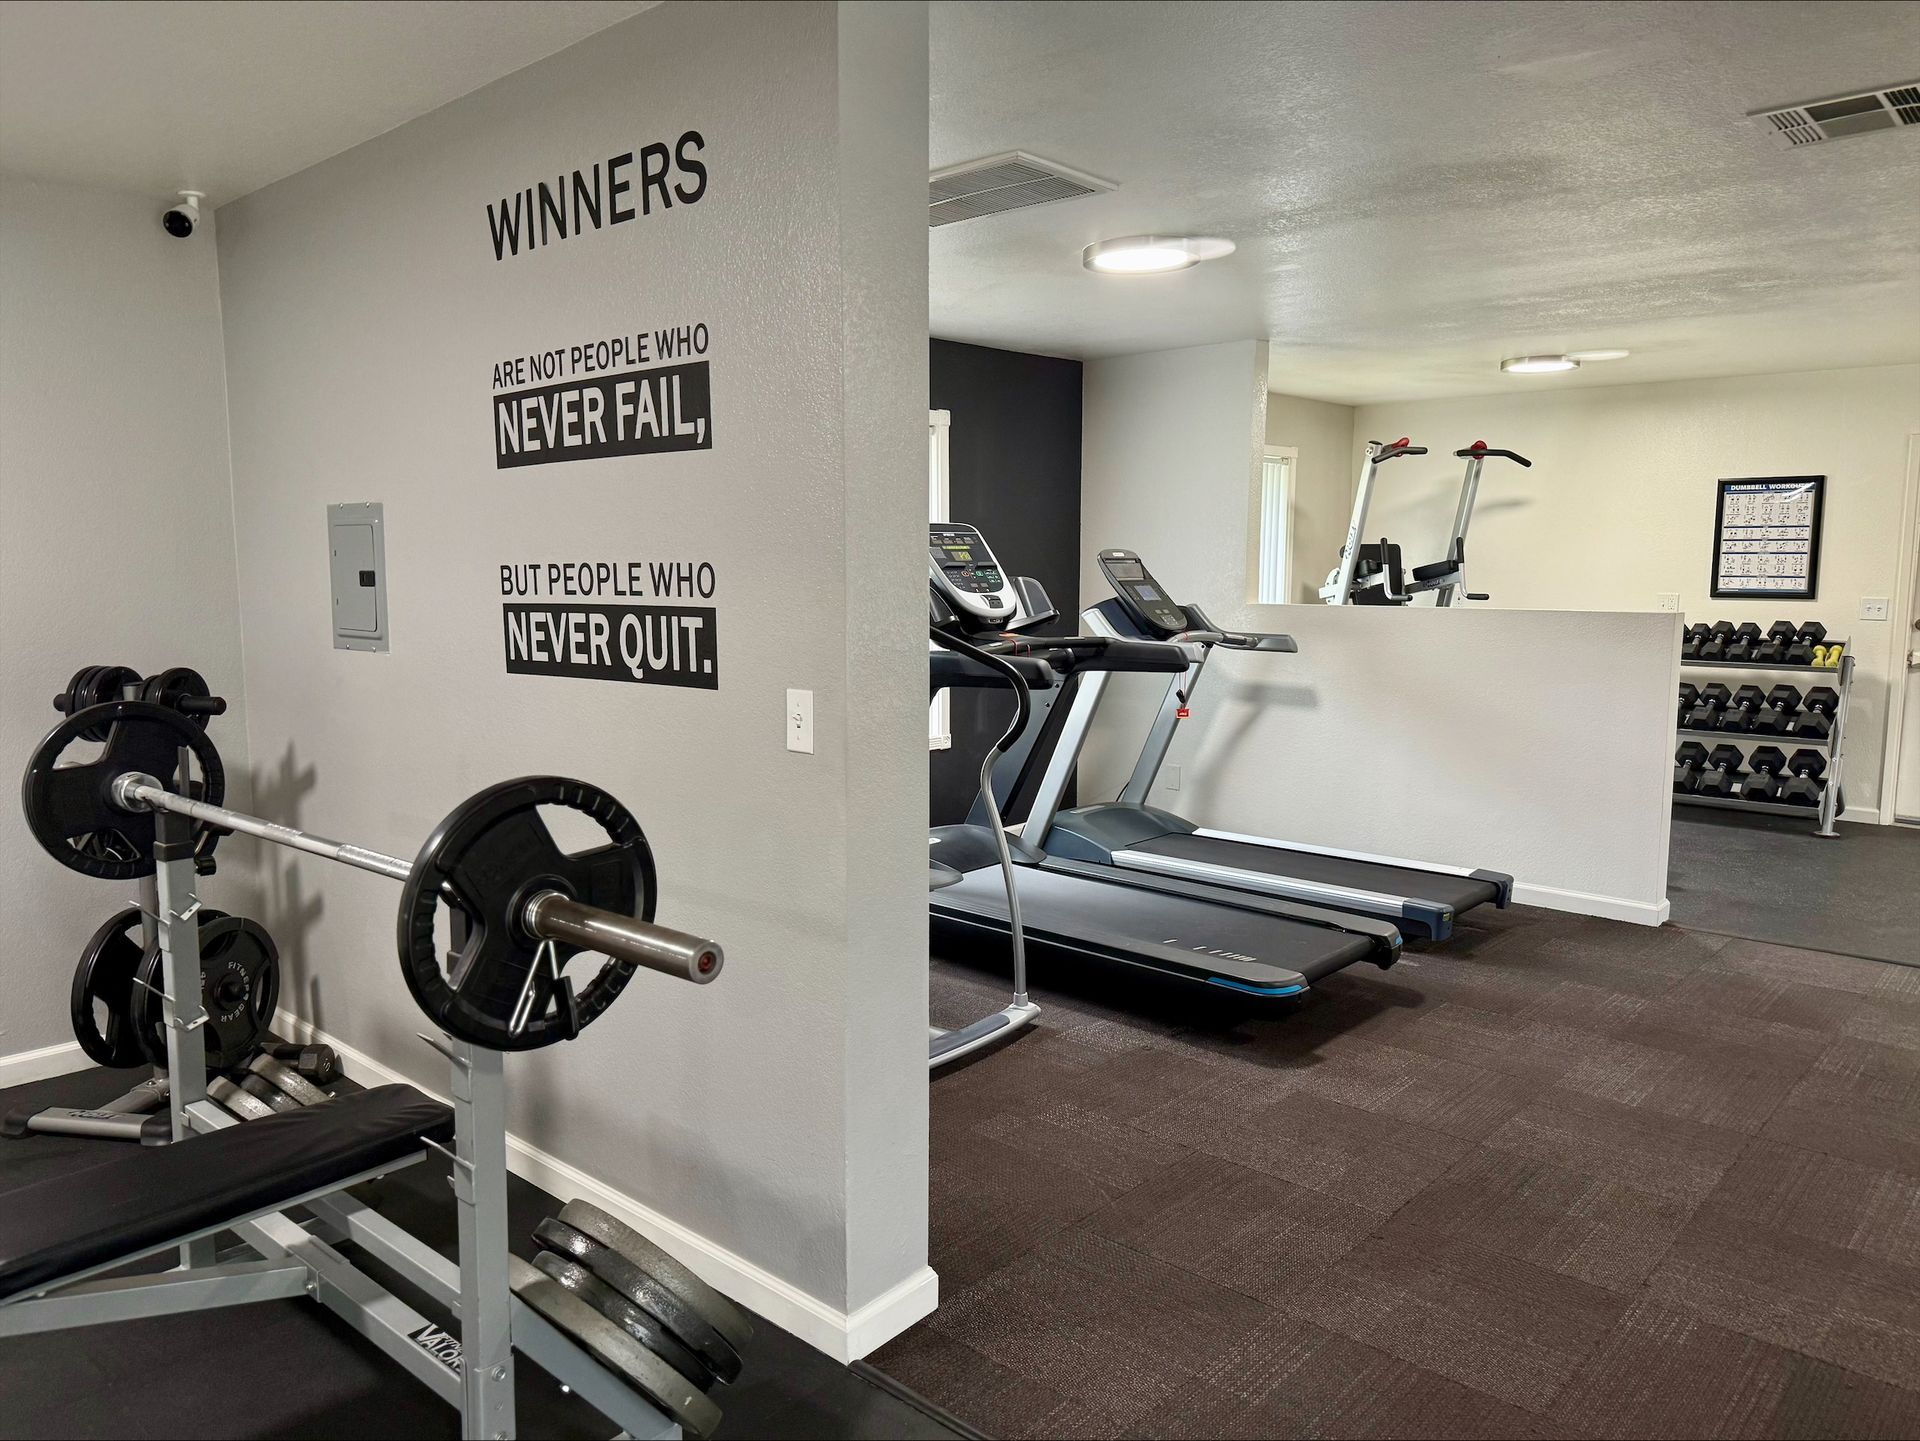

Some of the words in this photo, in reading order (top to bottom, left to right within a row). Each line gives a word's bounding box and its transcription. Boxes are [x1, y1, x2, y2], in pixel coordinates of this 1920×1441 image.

[486, 130, 708, 261] WINNERS
[492, 361, 526, 390] ARE
[529, 348, 566, 382] NOT
[571, 332, 650, 375] PEOPLE
[654, 322, 709, 360] WHO
[498, 384, 607, 455] NEVER
[615, 374, 706, 444] FAIL,
[1730, 483, 1767, 491] DUMBBELL
[1768, 482, 1812, 490] WORKOUT
[500, 563, 541, 596] BUT
[547, 562, 643, 597] PEOPLE
[648, 561, 716, 599] WHO
[507, 611, 612, 666] NEVER
[619, 613, 712, 680] QUIT.
[221, 1003, 245, 1022] GEAR
